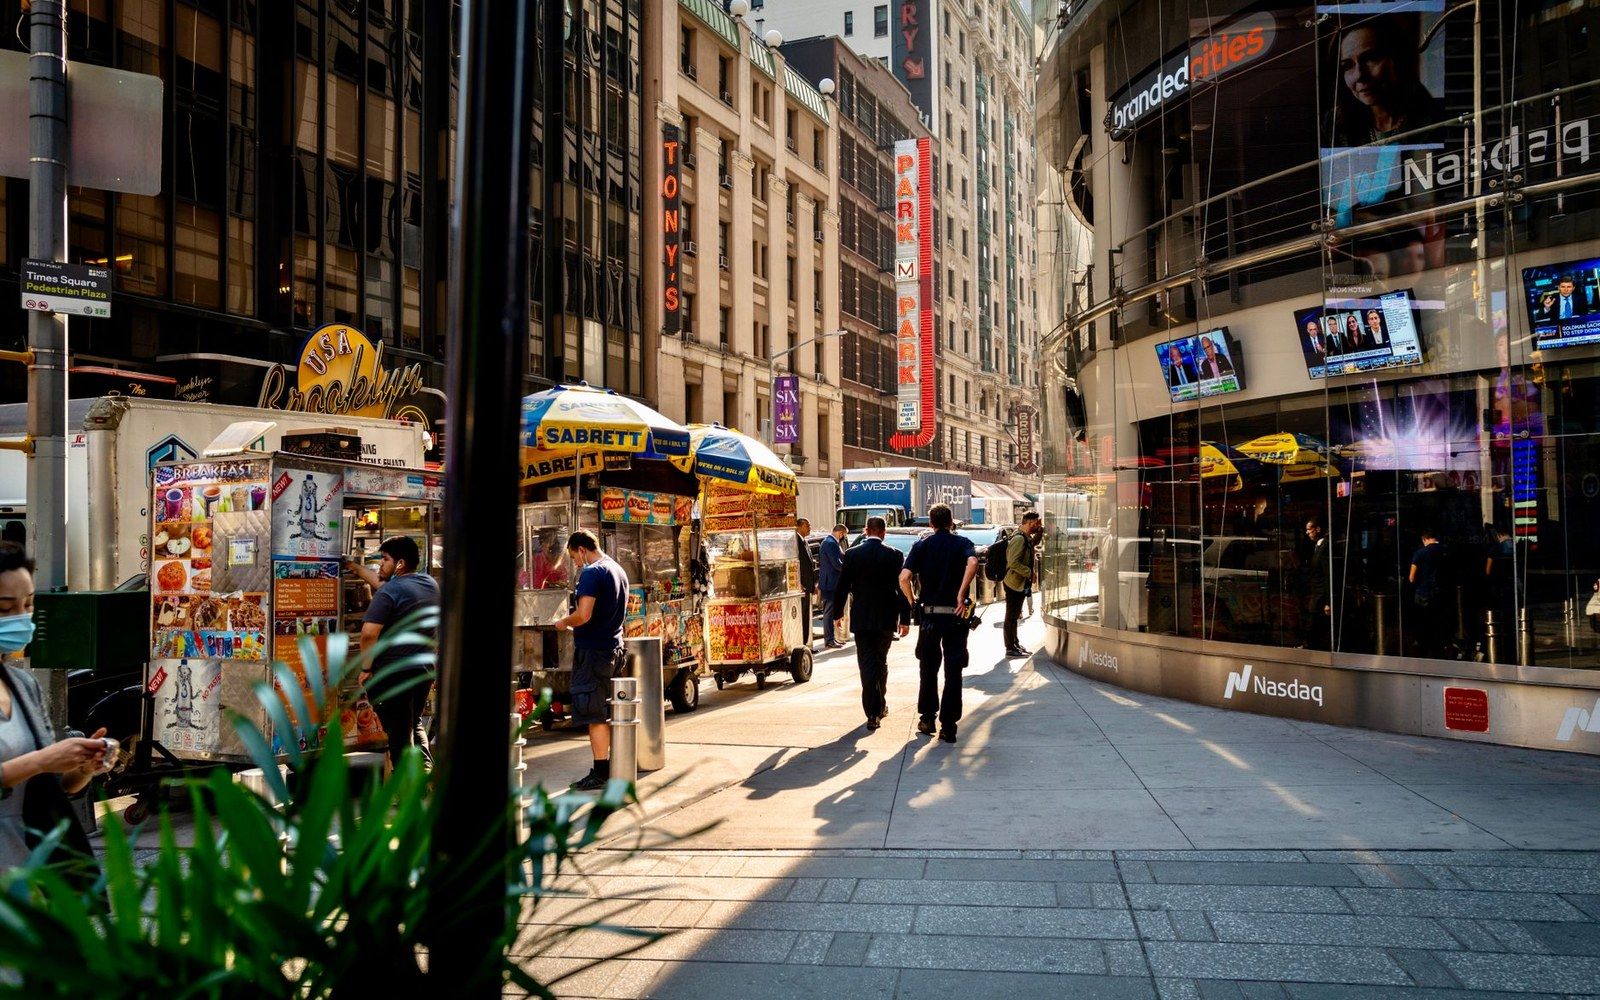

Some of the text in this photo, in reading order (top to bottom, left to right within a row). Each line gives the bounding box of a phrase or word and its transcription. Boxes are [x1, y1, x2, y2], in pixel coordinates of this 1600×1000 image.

[897, 154, 914, 244] PARK
[664, 141, 679, 312] TONY'S
[26, 271, 97, 288] Times Square
[26, 281, 107, 299] Pedestrian Plaza
[1562, 323, 1586, 331] GOLDMAN
[898, 296, 917, 385] PARK
[304, 329, 352, 375] USA
[129, 383, 146, 395] The
[257, 339, 424, 420] Brooklyn
[546, 426, 642, 447] SABRETT
[1019, 412, 1029, 468] BREWERY
[173, 463, 255, 481] BREAKFAST
[272, 476, 288, 496] NEW!
[862, 482, 901, 491] WESCO
[933, 485, 964, 505] WESCO
[1089, 649, 1118, 673] Nasdaq
[148, 672, 164, 692] NEW!
[1254, 676, 1323, 707] Nasdaq
